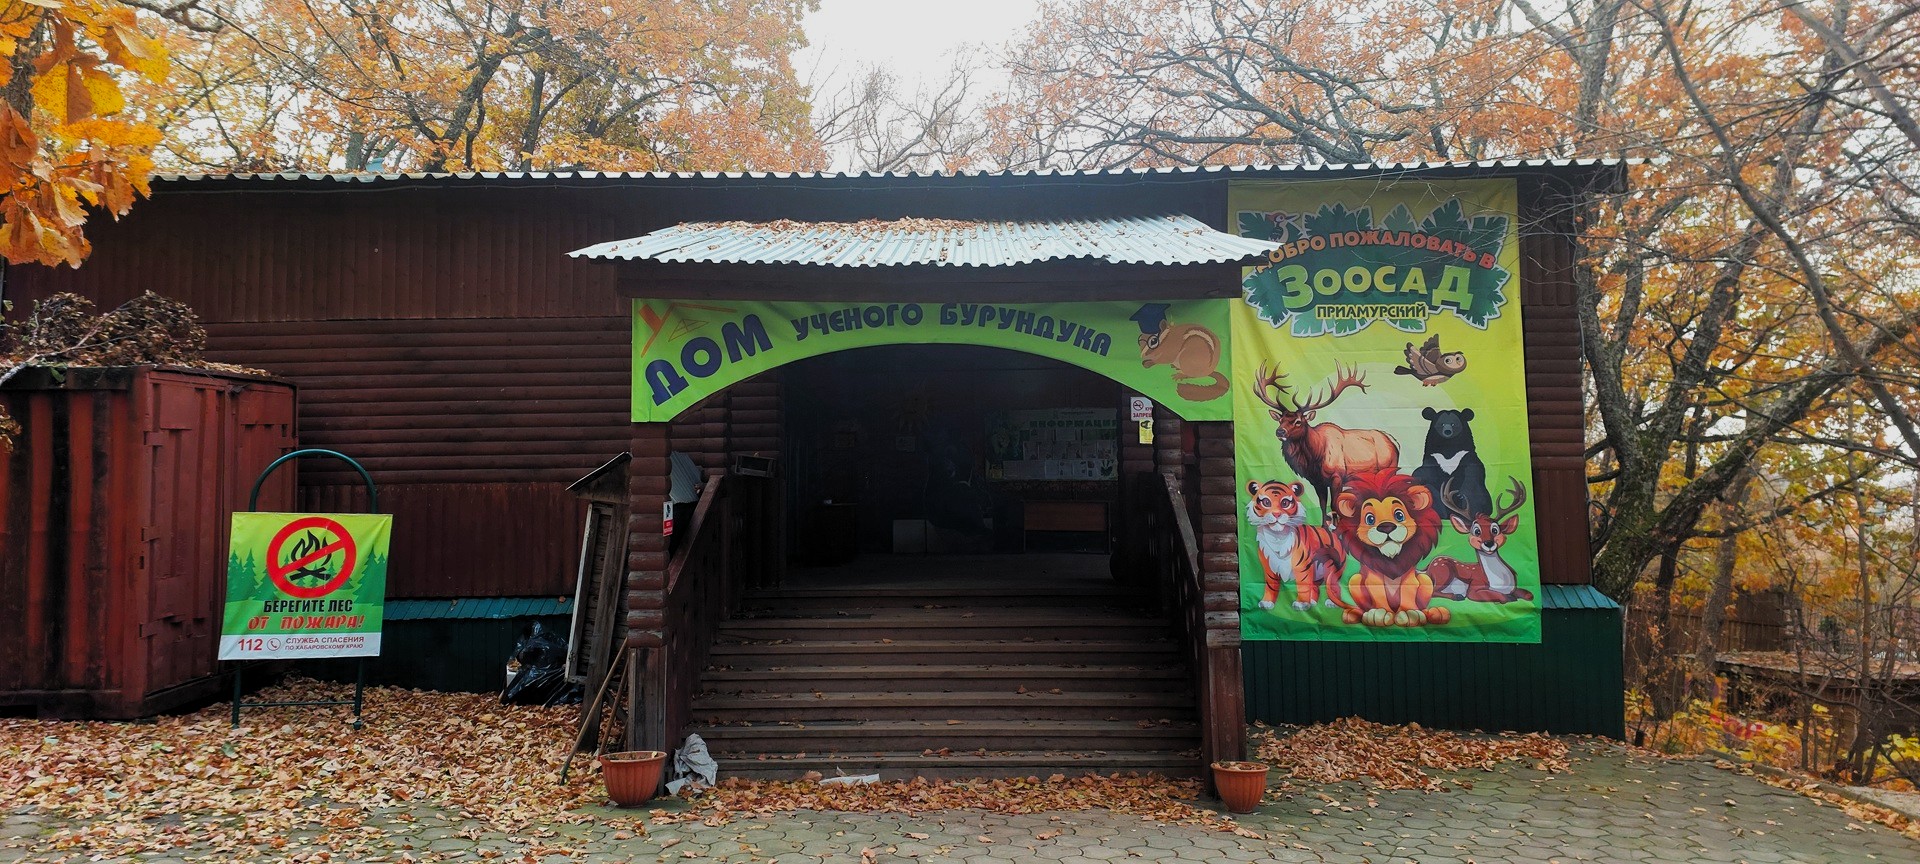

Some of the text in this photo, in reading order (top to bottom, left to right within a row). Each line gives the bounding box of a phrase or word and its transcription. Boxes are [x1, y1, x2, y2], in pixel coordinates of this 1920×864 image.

[1330, 231, 1477, 263] ПОЖАЛОВАТЬ
[1479, 251, 1496, 269] В
[1277, 264, 1474, 310] ЗООСАД
[1316, 304, 1427, 318] ПРИАМУРСКИЙ
[645, 303, 1112, 407] ДОМ УЧЕНОГО БУРУНДУКА
[263, 600, 353, 613] БЕРЕГИТЕ ЛЕС
[248, 614, 365, 630] ОТ ПОЖАРА!
[238, 638, 263, 651] 112
